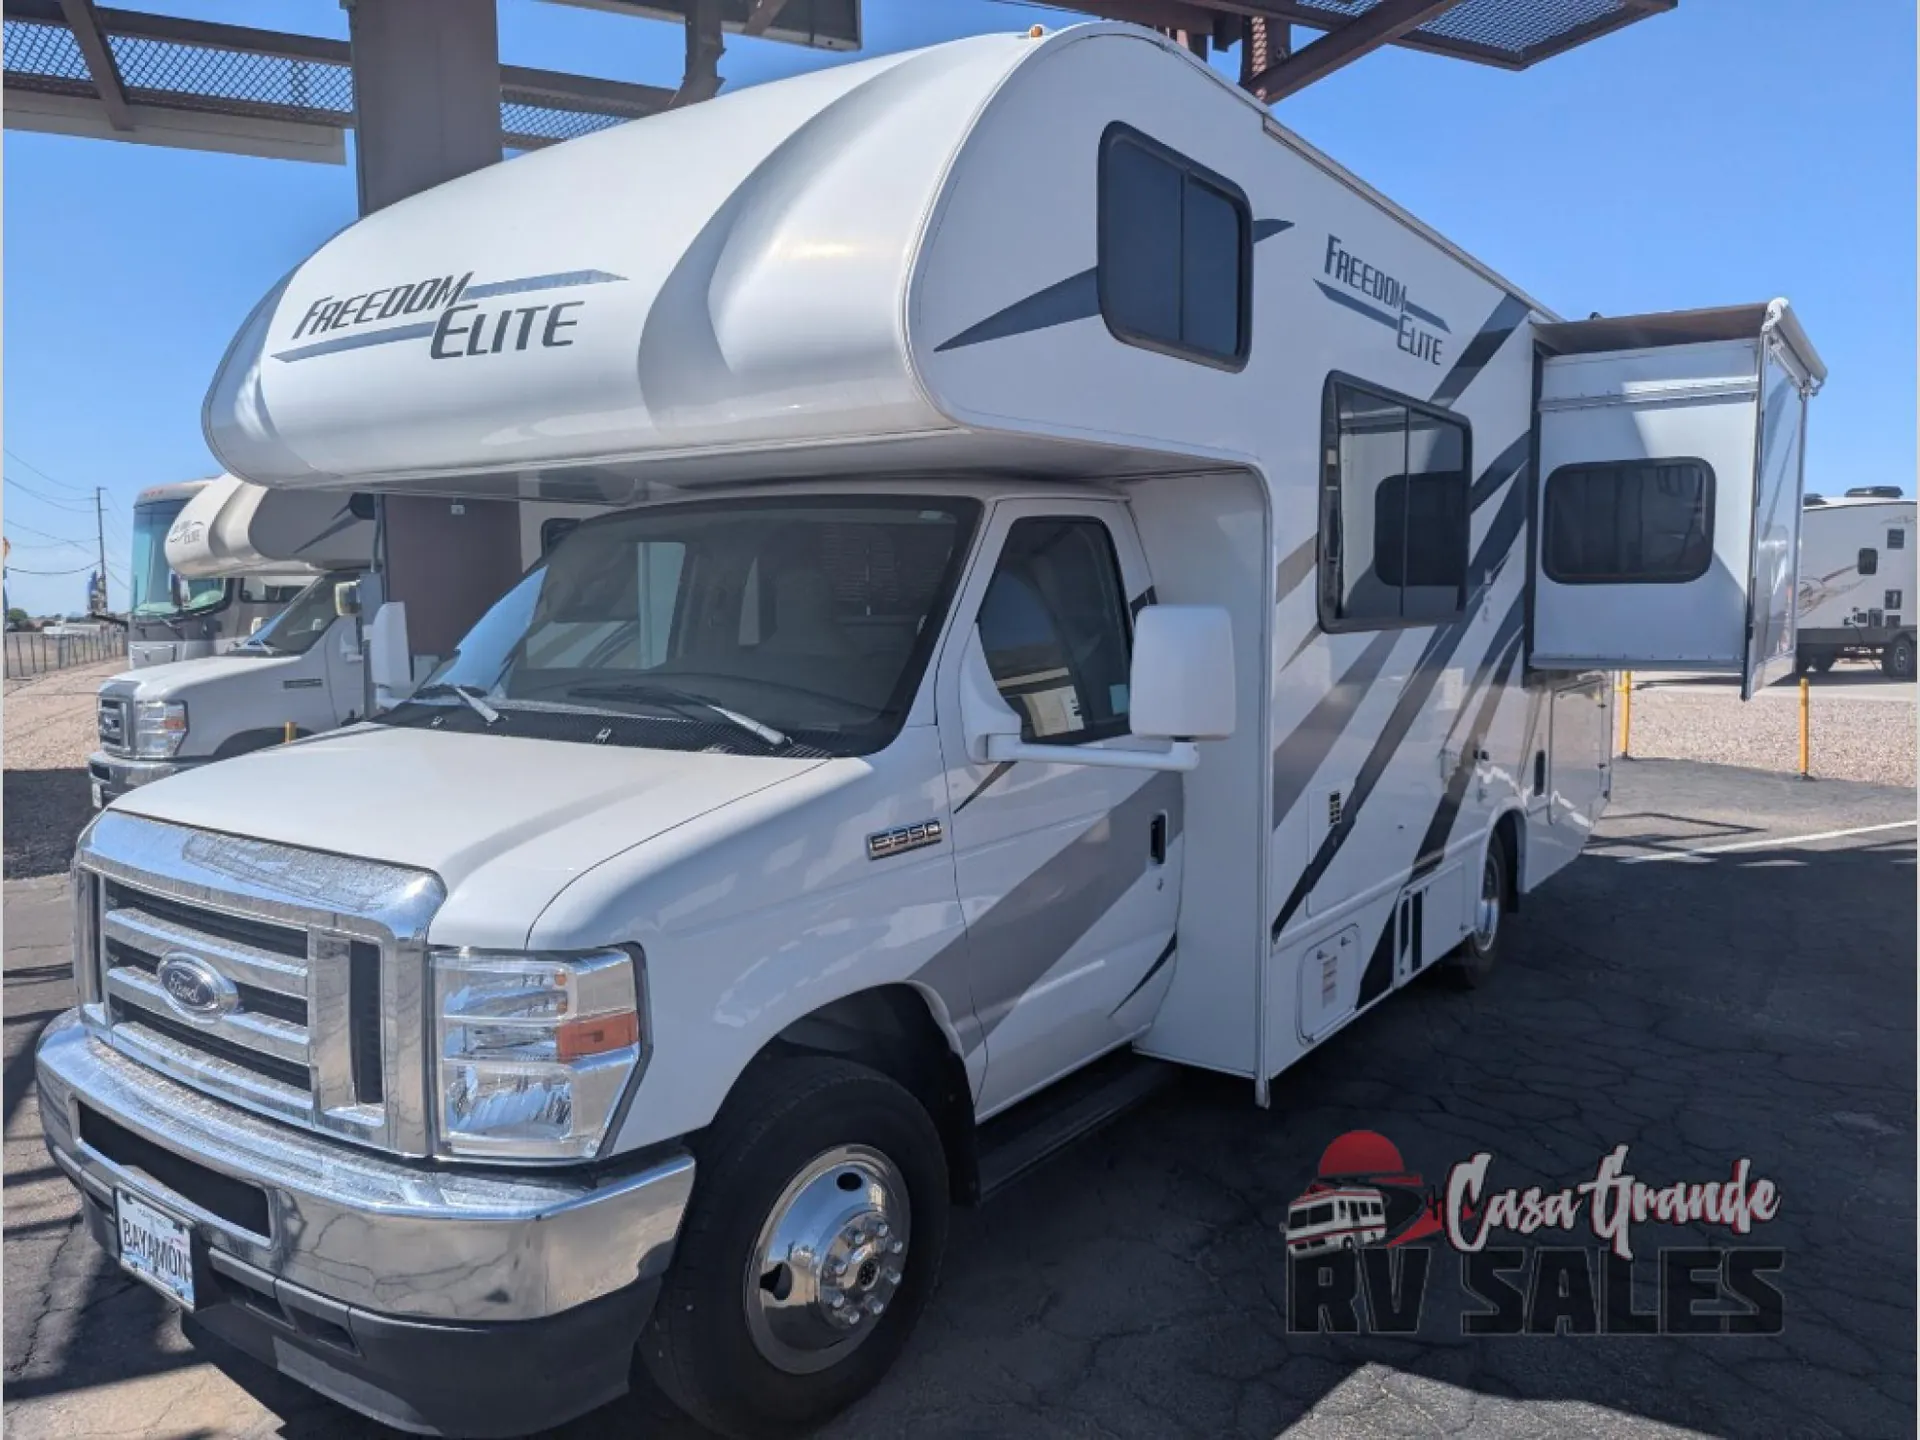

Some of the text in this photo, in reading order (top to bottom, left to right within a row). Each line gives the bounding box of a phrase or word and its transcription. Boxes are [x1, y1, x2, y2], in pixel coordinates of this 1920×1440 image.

[293, 272, 474, 339] FREEDOM
[1325, 234, 1408, 312] FREEDOM
[431, 301, 585, 359] ELITE
[1397, 314, 1443, 366] ELITE
[122, 1217, 189, 1283] BAYAMON
